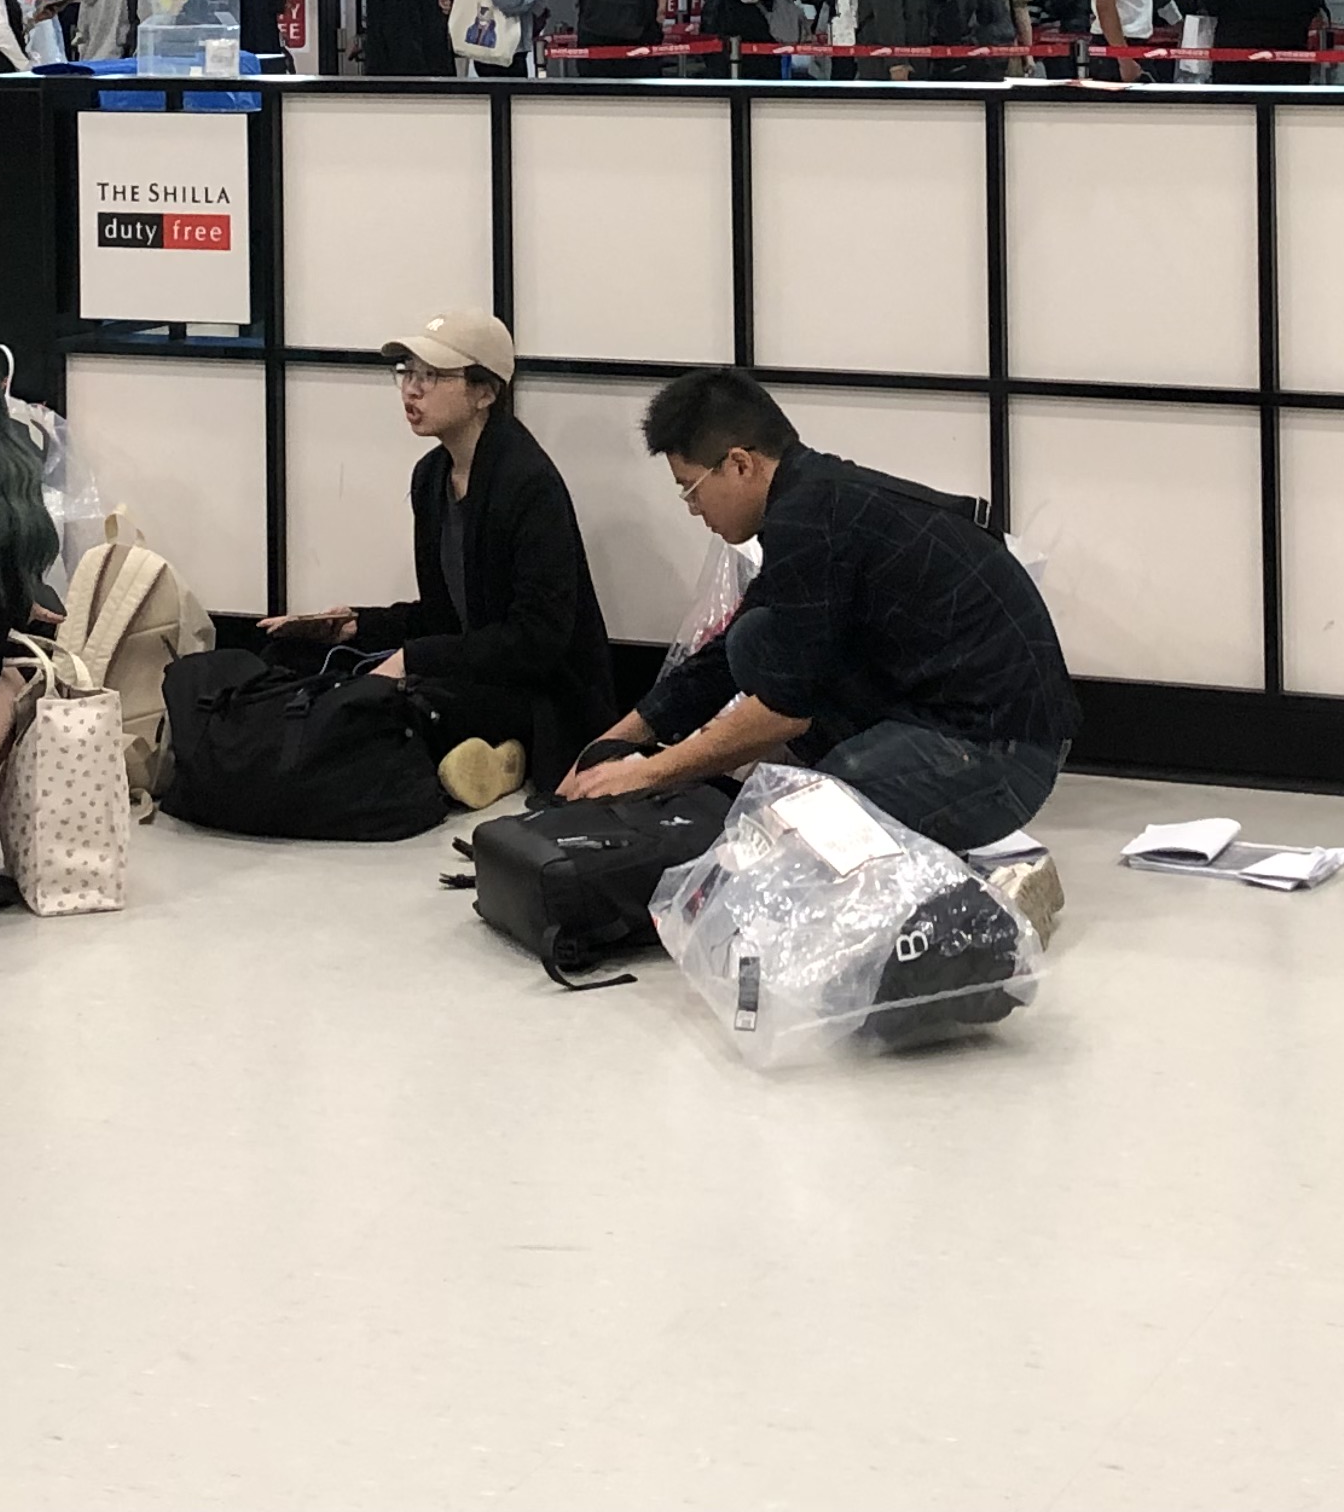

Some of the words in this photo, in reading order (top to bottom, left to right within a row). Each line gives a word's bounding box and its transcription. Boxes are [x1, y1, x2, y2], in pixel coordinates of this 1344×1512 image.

[97, 182, 139, 202] THE
[148, 182, 230, 204] SHILLA
[104, 218, 157, 245] duty
[172, 219, 223, 241] free
